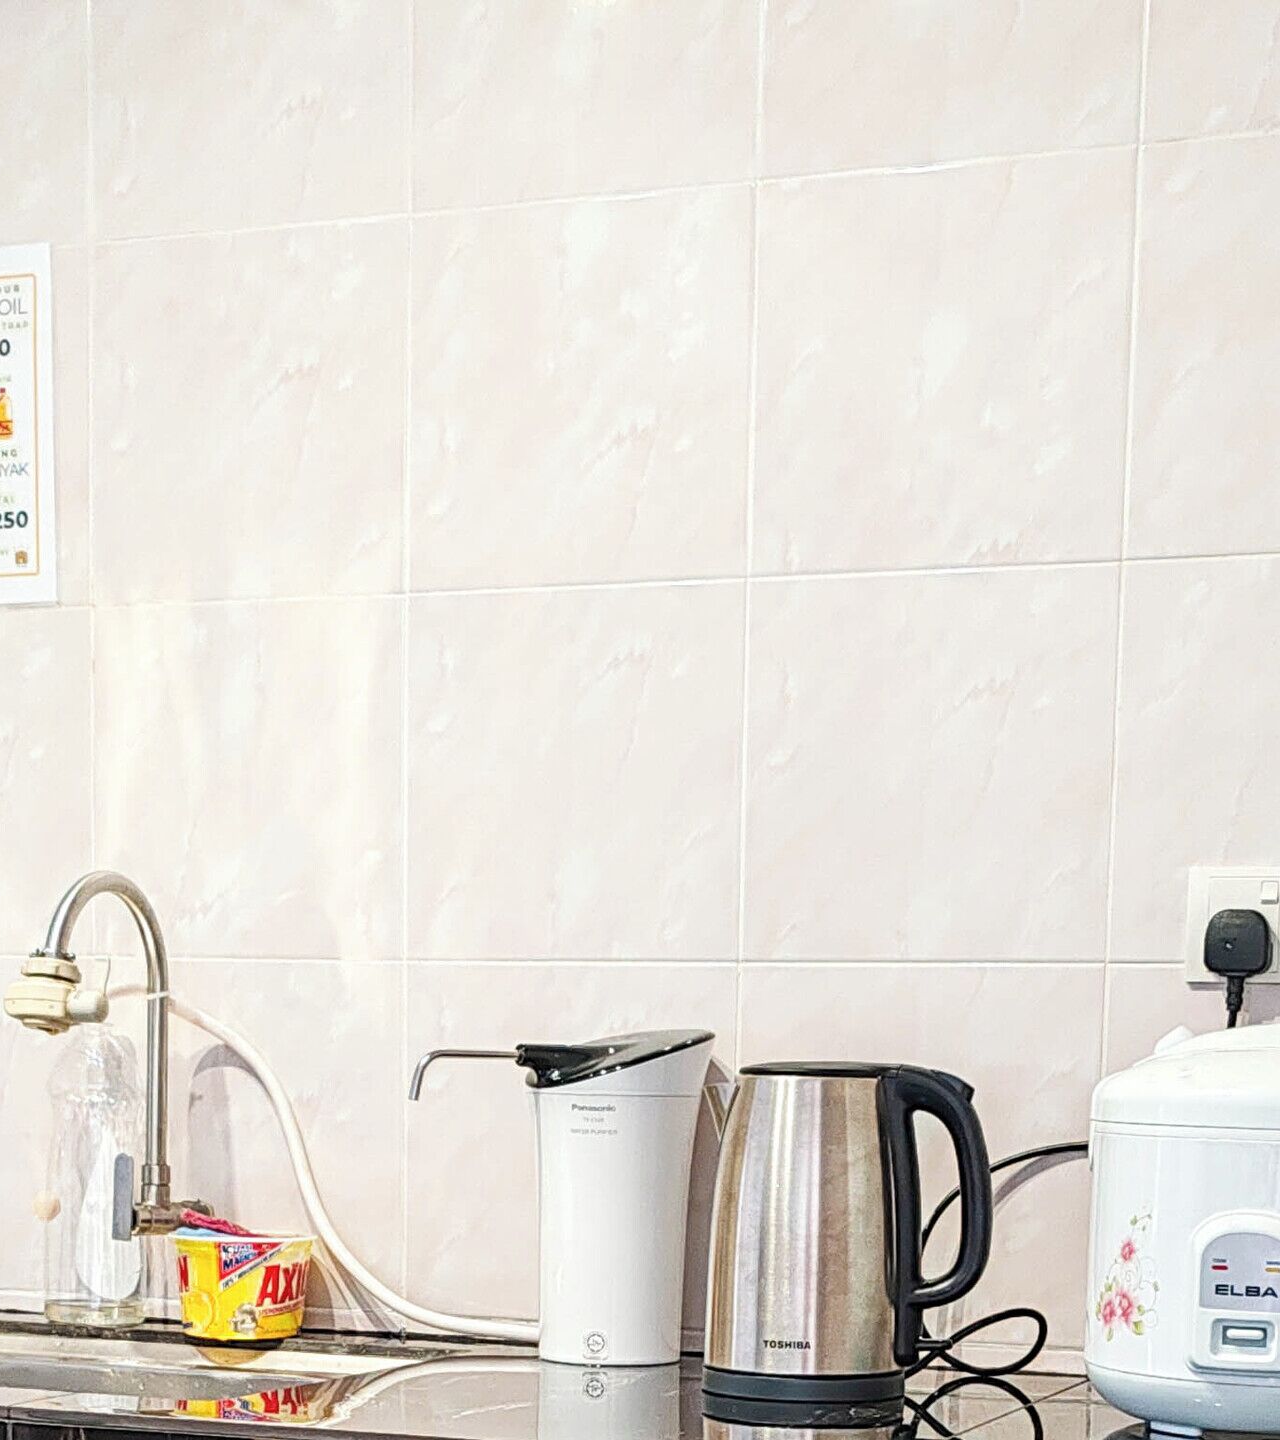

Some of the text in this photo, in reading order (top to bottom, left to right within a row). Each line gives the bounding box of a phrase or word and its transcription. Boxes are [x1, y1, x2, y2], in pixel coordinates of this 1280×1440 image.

[571, 1103, 616, 1112] Panasonic
[1214, 1284, 1279, 1298] ELBA
[763, 1340, 811, 1350] TOSHIBA
